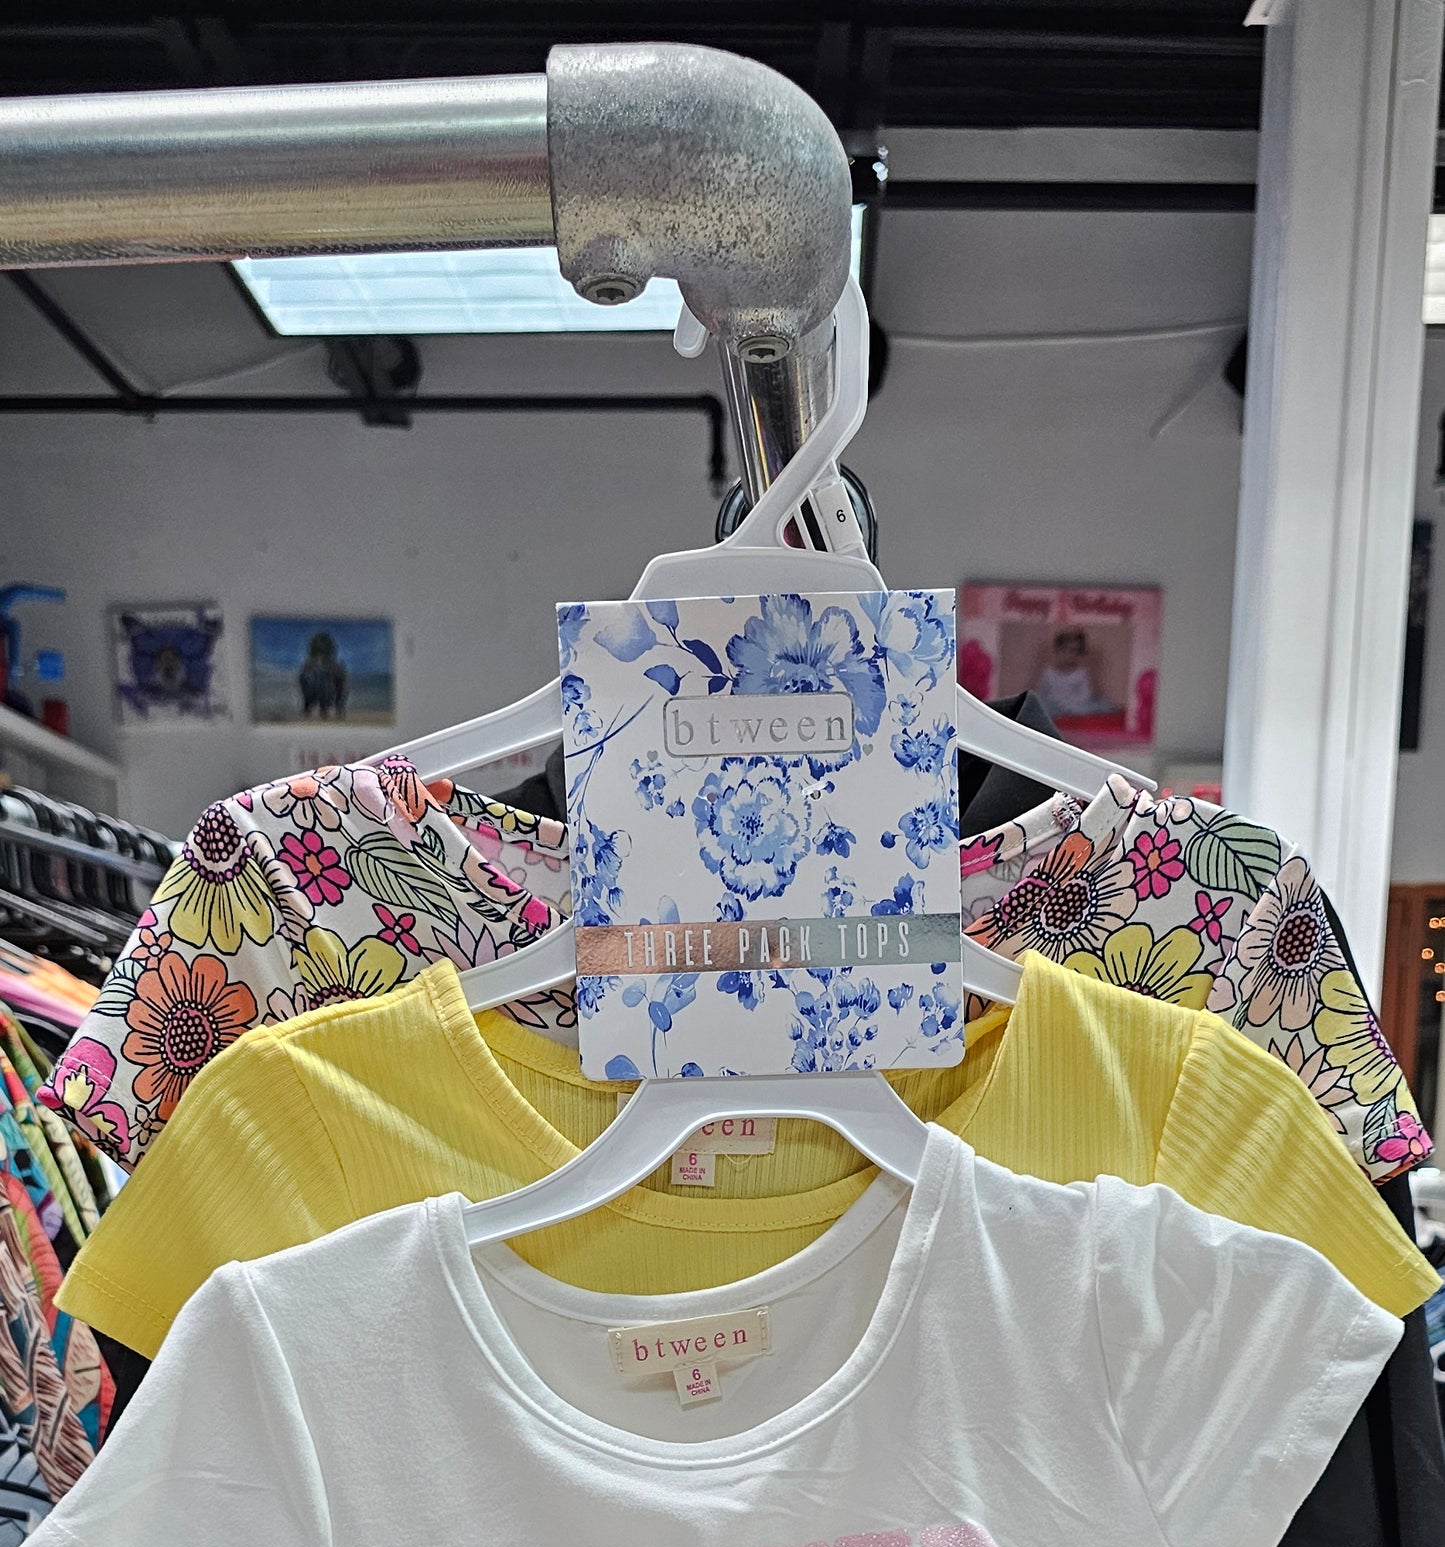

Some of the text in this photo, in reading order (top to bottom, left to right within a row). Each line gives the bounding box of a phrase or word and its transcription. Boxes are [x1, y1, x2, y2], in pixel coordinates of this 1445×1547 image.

[836, 509, 847, 523] 6
[672, 709, 848, 746] btween
[624, 921, 910, 968] THREE PACK TOPS
[702, 1118, 756, 1136] een
[689, 1153, 697, 1165] 6
[632, 1328, 748, 1362] btween
[692, 1368, 701, 1380] 6
[686, 1380, 704, 1391] MADE
[691, 1386, 710, 1396] CHINA
